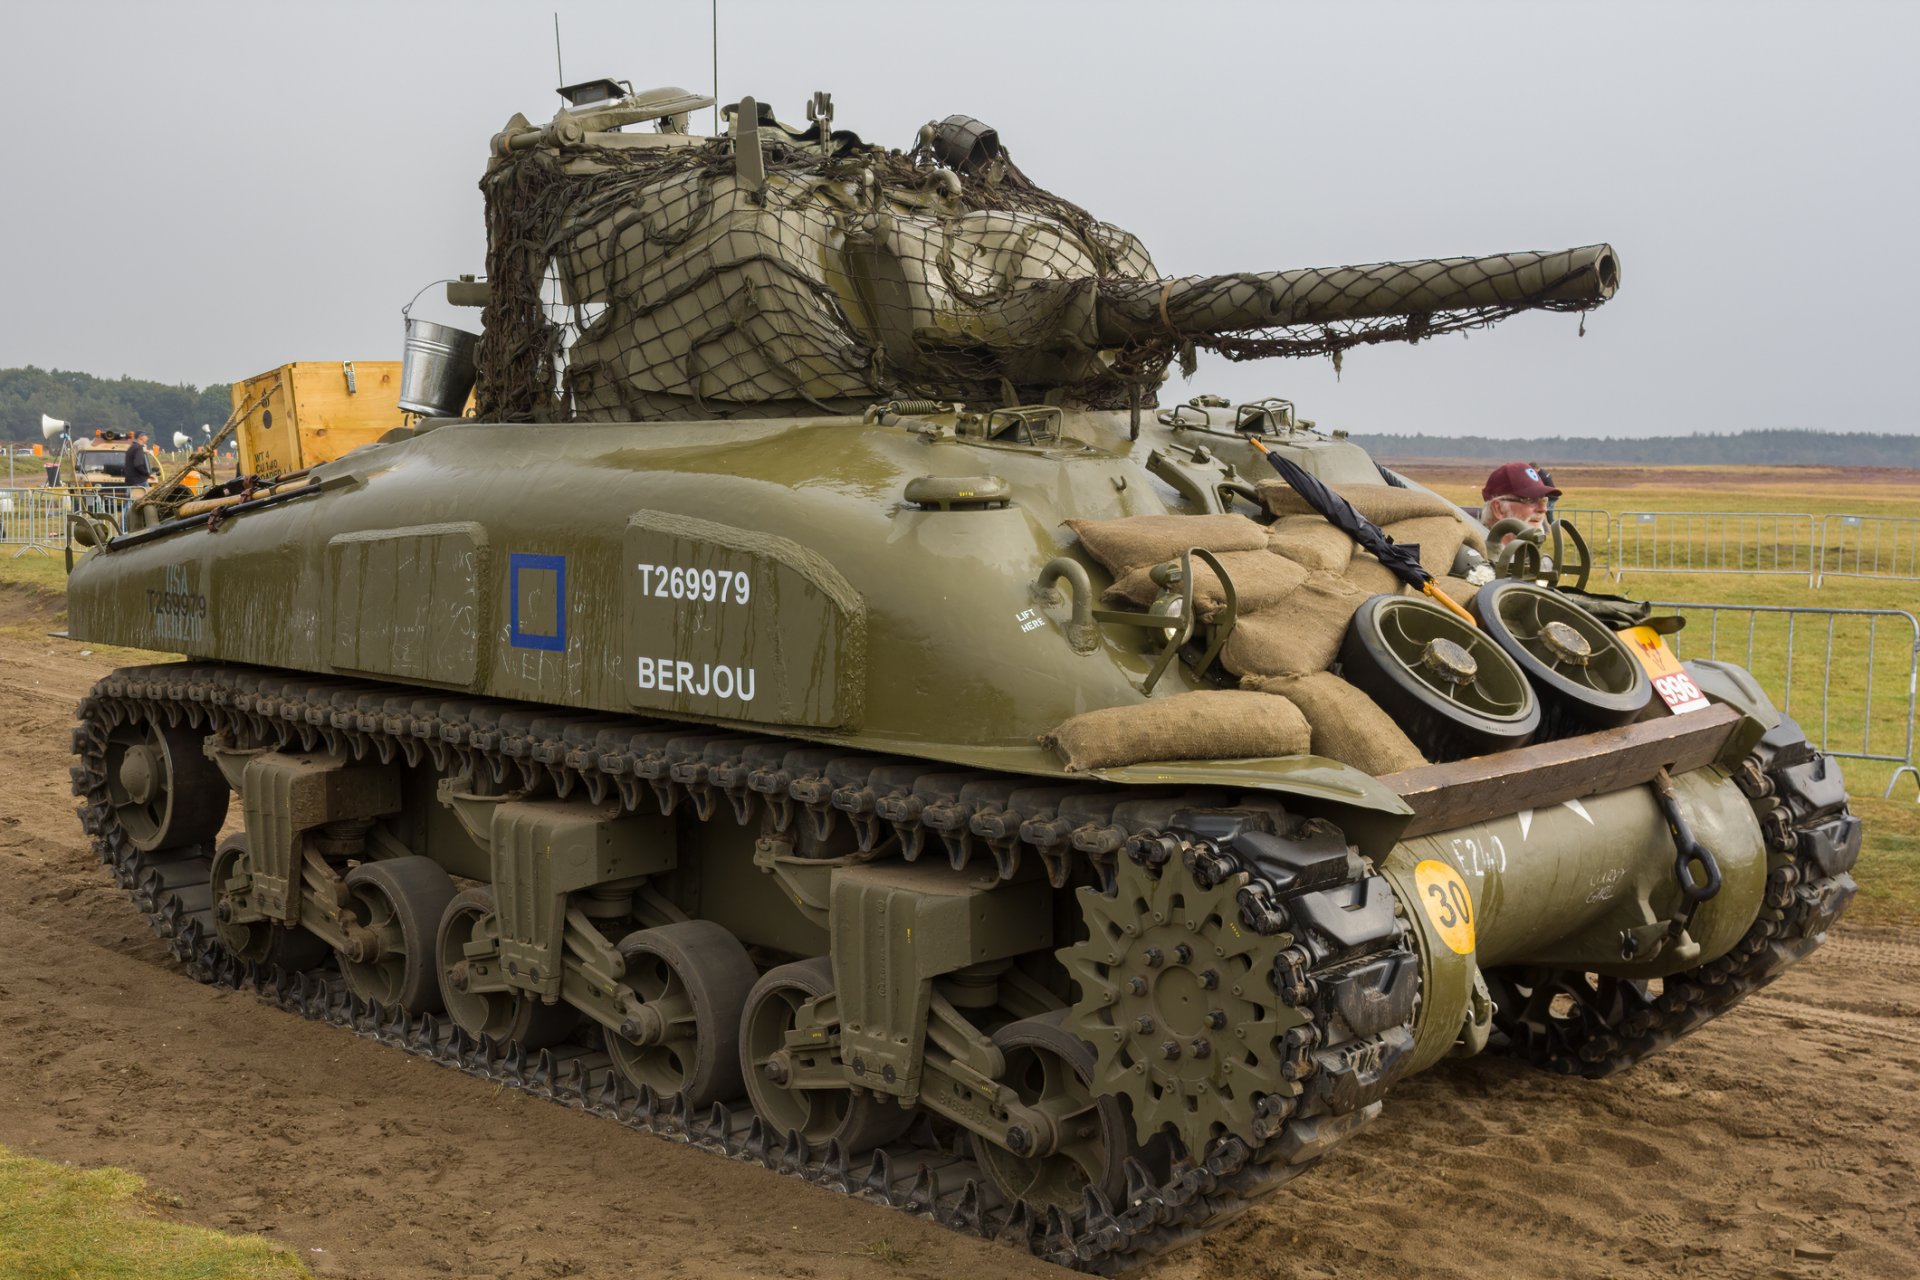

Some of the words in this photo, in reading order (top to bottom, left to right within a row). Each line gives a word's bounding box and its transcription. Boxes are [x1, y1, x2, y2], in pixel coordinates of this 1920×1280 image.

[165, 563, 189, 596] USA
[638, 563, 751, 605] T269979
[146, 589, 207, 620] T269979
[1015, 608, 1035, 622] LIFT
[1021, 617, 1046, 633] HERE
[638, 656, 755, 701] BERJOU
[1655, 672, 1700, 705] 996
[1428, 880, 1469, 928] 30
